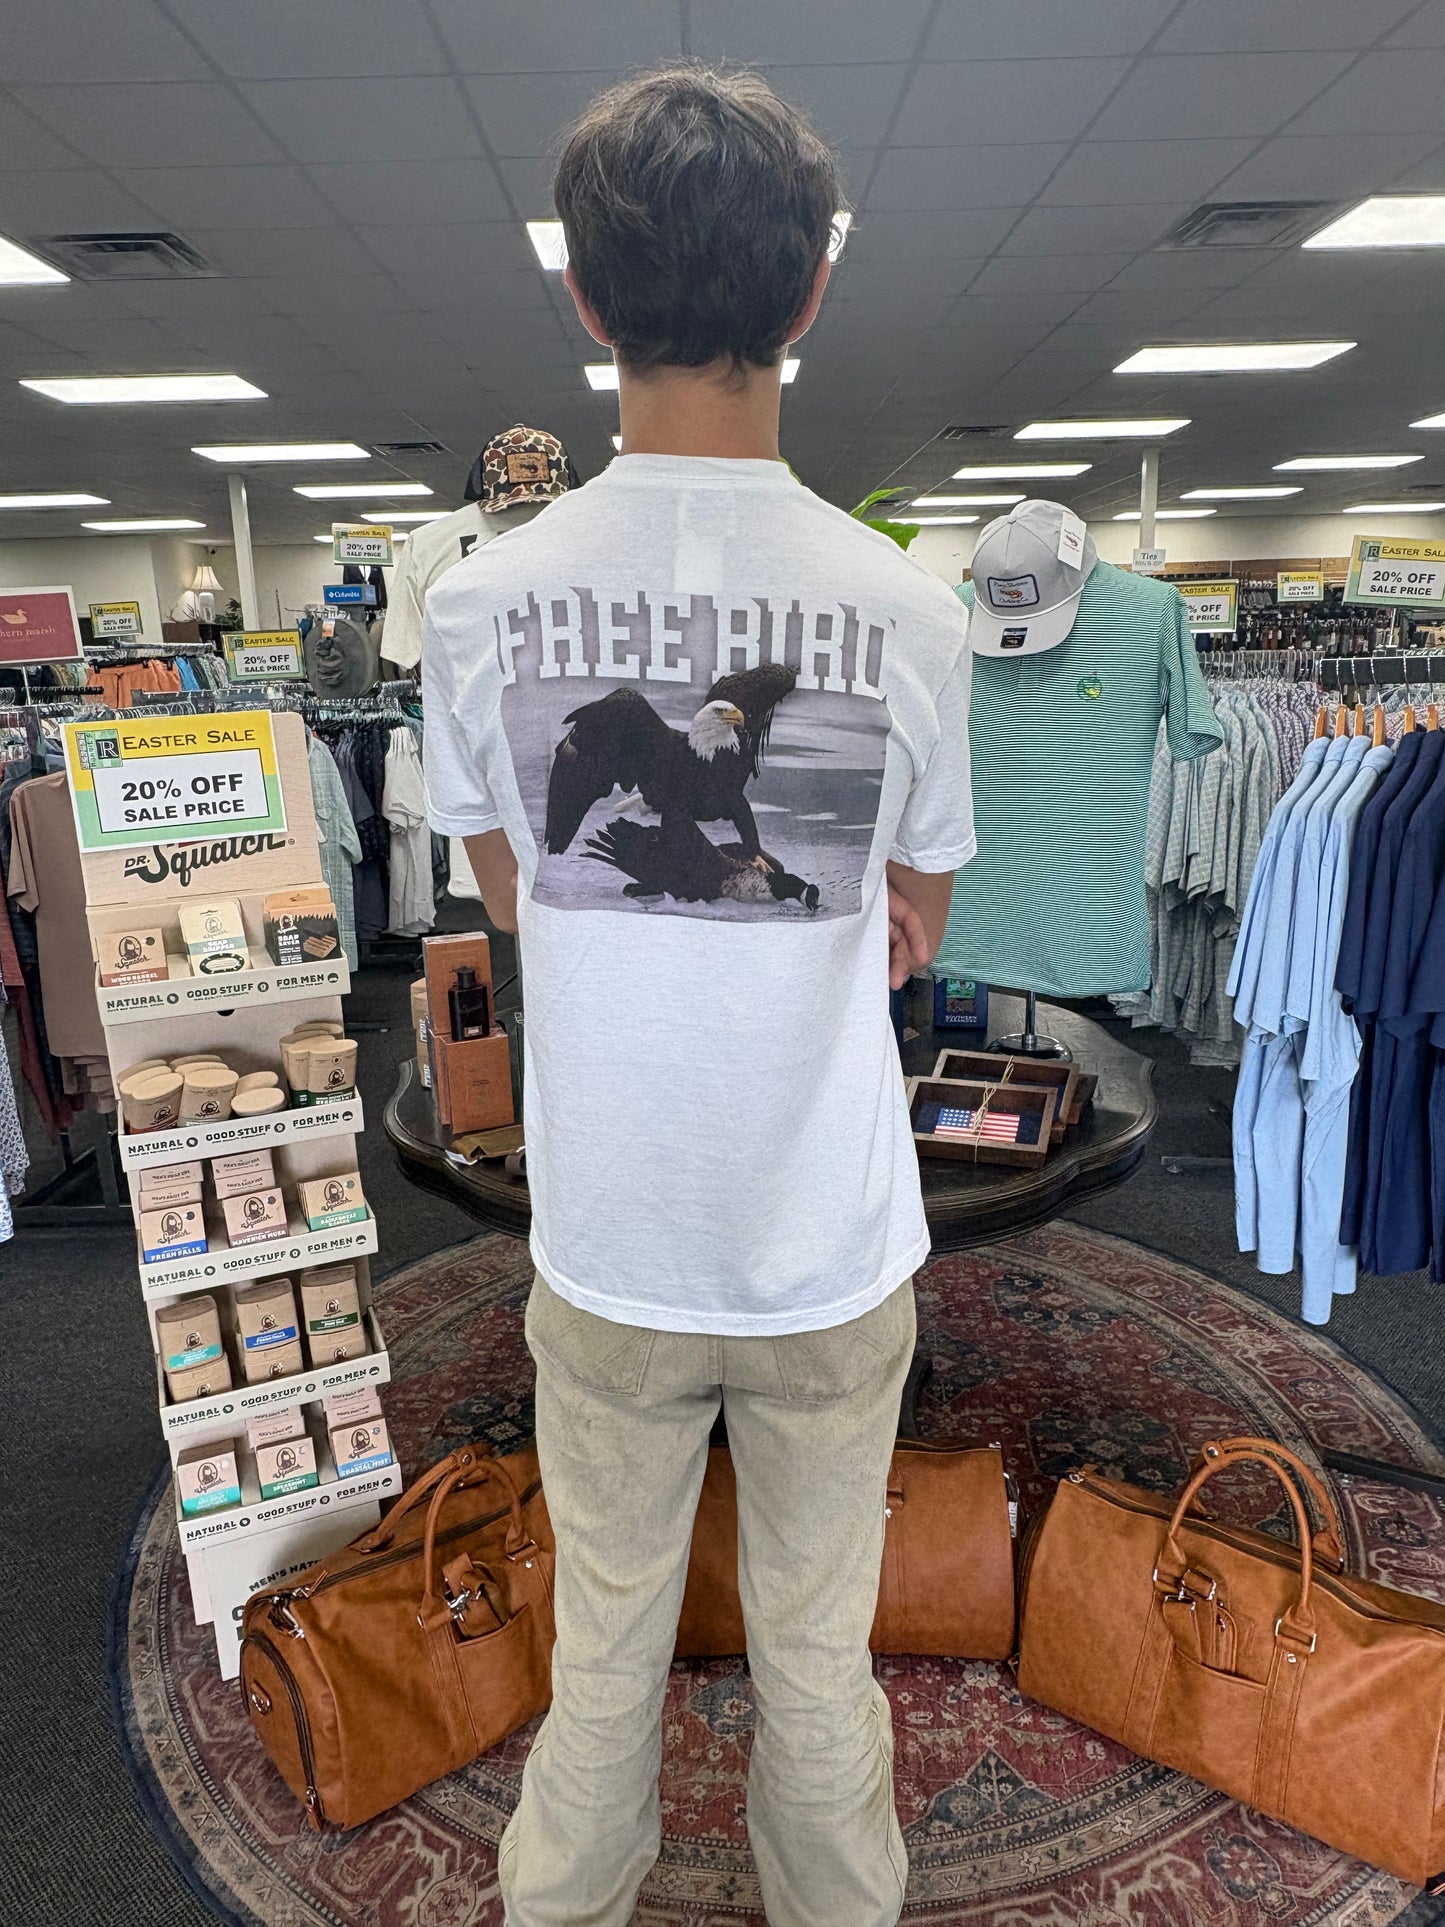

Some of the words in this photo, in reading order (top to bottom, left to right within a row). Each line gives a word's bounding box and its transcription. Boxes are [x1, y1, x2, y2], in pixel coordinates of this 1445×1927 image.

[1141, 552, 1158, 560] Ties
[1382, 546, 1420, 556] EASTER
[1424, 548, 1445, 557] SAL
[1372, 570, 1402, 582] 20%
[1408, 572, 1436, 584] OFF
[1370, 585, 1398, 594] SALE
[1400, 586, 1432, 596] PRICE
[1200, 604, 1222, 612] OFF
[26, 625, 56, 636] marsh
[494, 586, 691, 683] FREE
[712, 596, 897, 701] BIRD
[244, 656, 266, 664] 20%
[270, 654, 290, 662] OFF
[98, 740, 119, 758] R
[122, 734, 197, 750] EASTER
[207, 730, 256, 744] SALE
[121, 778, 182, 802] 20%
[191, 774, 243, 794] OFF
[124, 806, 178, 822] SALE
[184, 800, 246, 817] PRICE
[124, 834, 285, 888] Squatch
[124, 855, 151, 868] DR.
[106, 995, 164, 1009] NATURAL
[187, 988, 218, 998] GOOD
[220, 983, 254, 994] STUFF
[276, 976, 298, 987] FOR
[301, 974, 324, 984] MEN
[128, 1139, 183, 1154] NATURAL
[206, 1130, 236, 1142] GOOD
[238, 1124, 270, 1136] STUFF
[293, 1116, 314, 1127] FOR
[316, 1112, 340, 1124] MEN
[148, 1268, 200, 1284] NATURAL
[224, 1258, 252, 1270] GOOD
[254, 1251, 286, 1263] STUFF
[308, 1242, 328, 1252] FOR
[330, 1237, 352, 1248] MEN
[178, 1246, 202, 1256] FALLS
[168, 1408, 220, 1426] NATURAL
[241, 1395, 268, 1407] GOOD
[271, 1386, 302, 1400] STUFF
[322, 1376, 342, 1386] FOR
[345, 1369, 366, 1380] MEN
[340, 1464, 372, 1476] COASTAL
[186, 1520, 236, 1539] NATURAL
[257, 1508, 284, 1520] GOOD
[286, 1498, 317, 1512] STUFF
[336, 1488, 356, 1498] FOR
[358, 1480, 380, 1492] MEN
[249, 1568, 288, 1592] MEN'S
